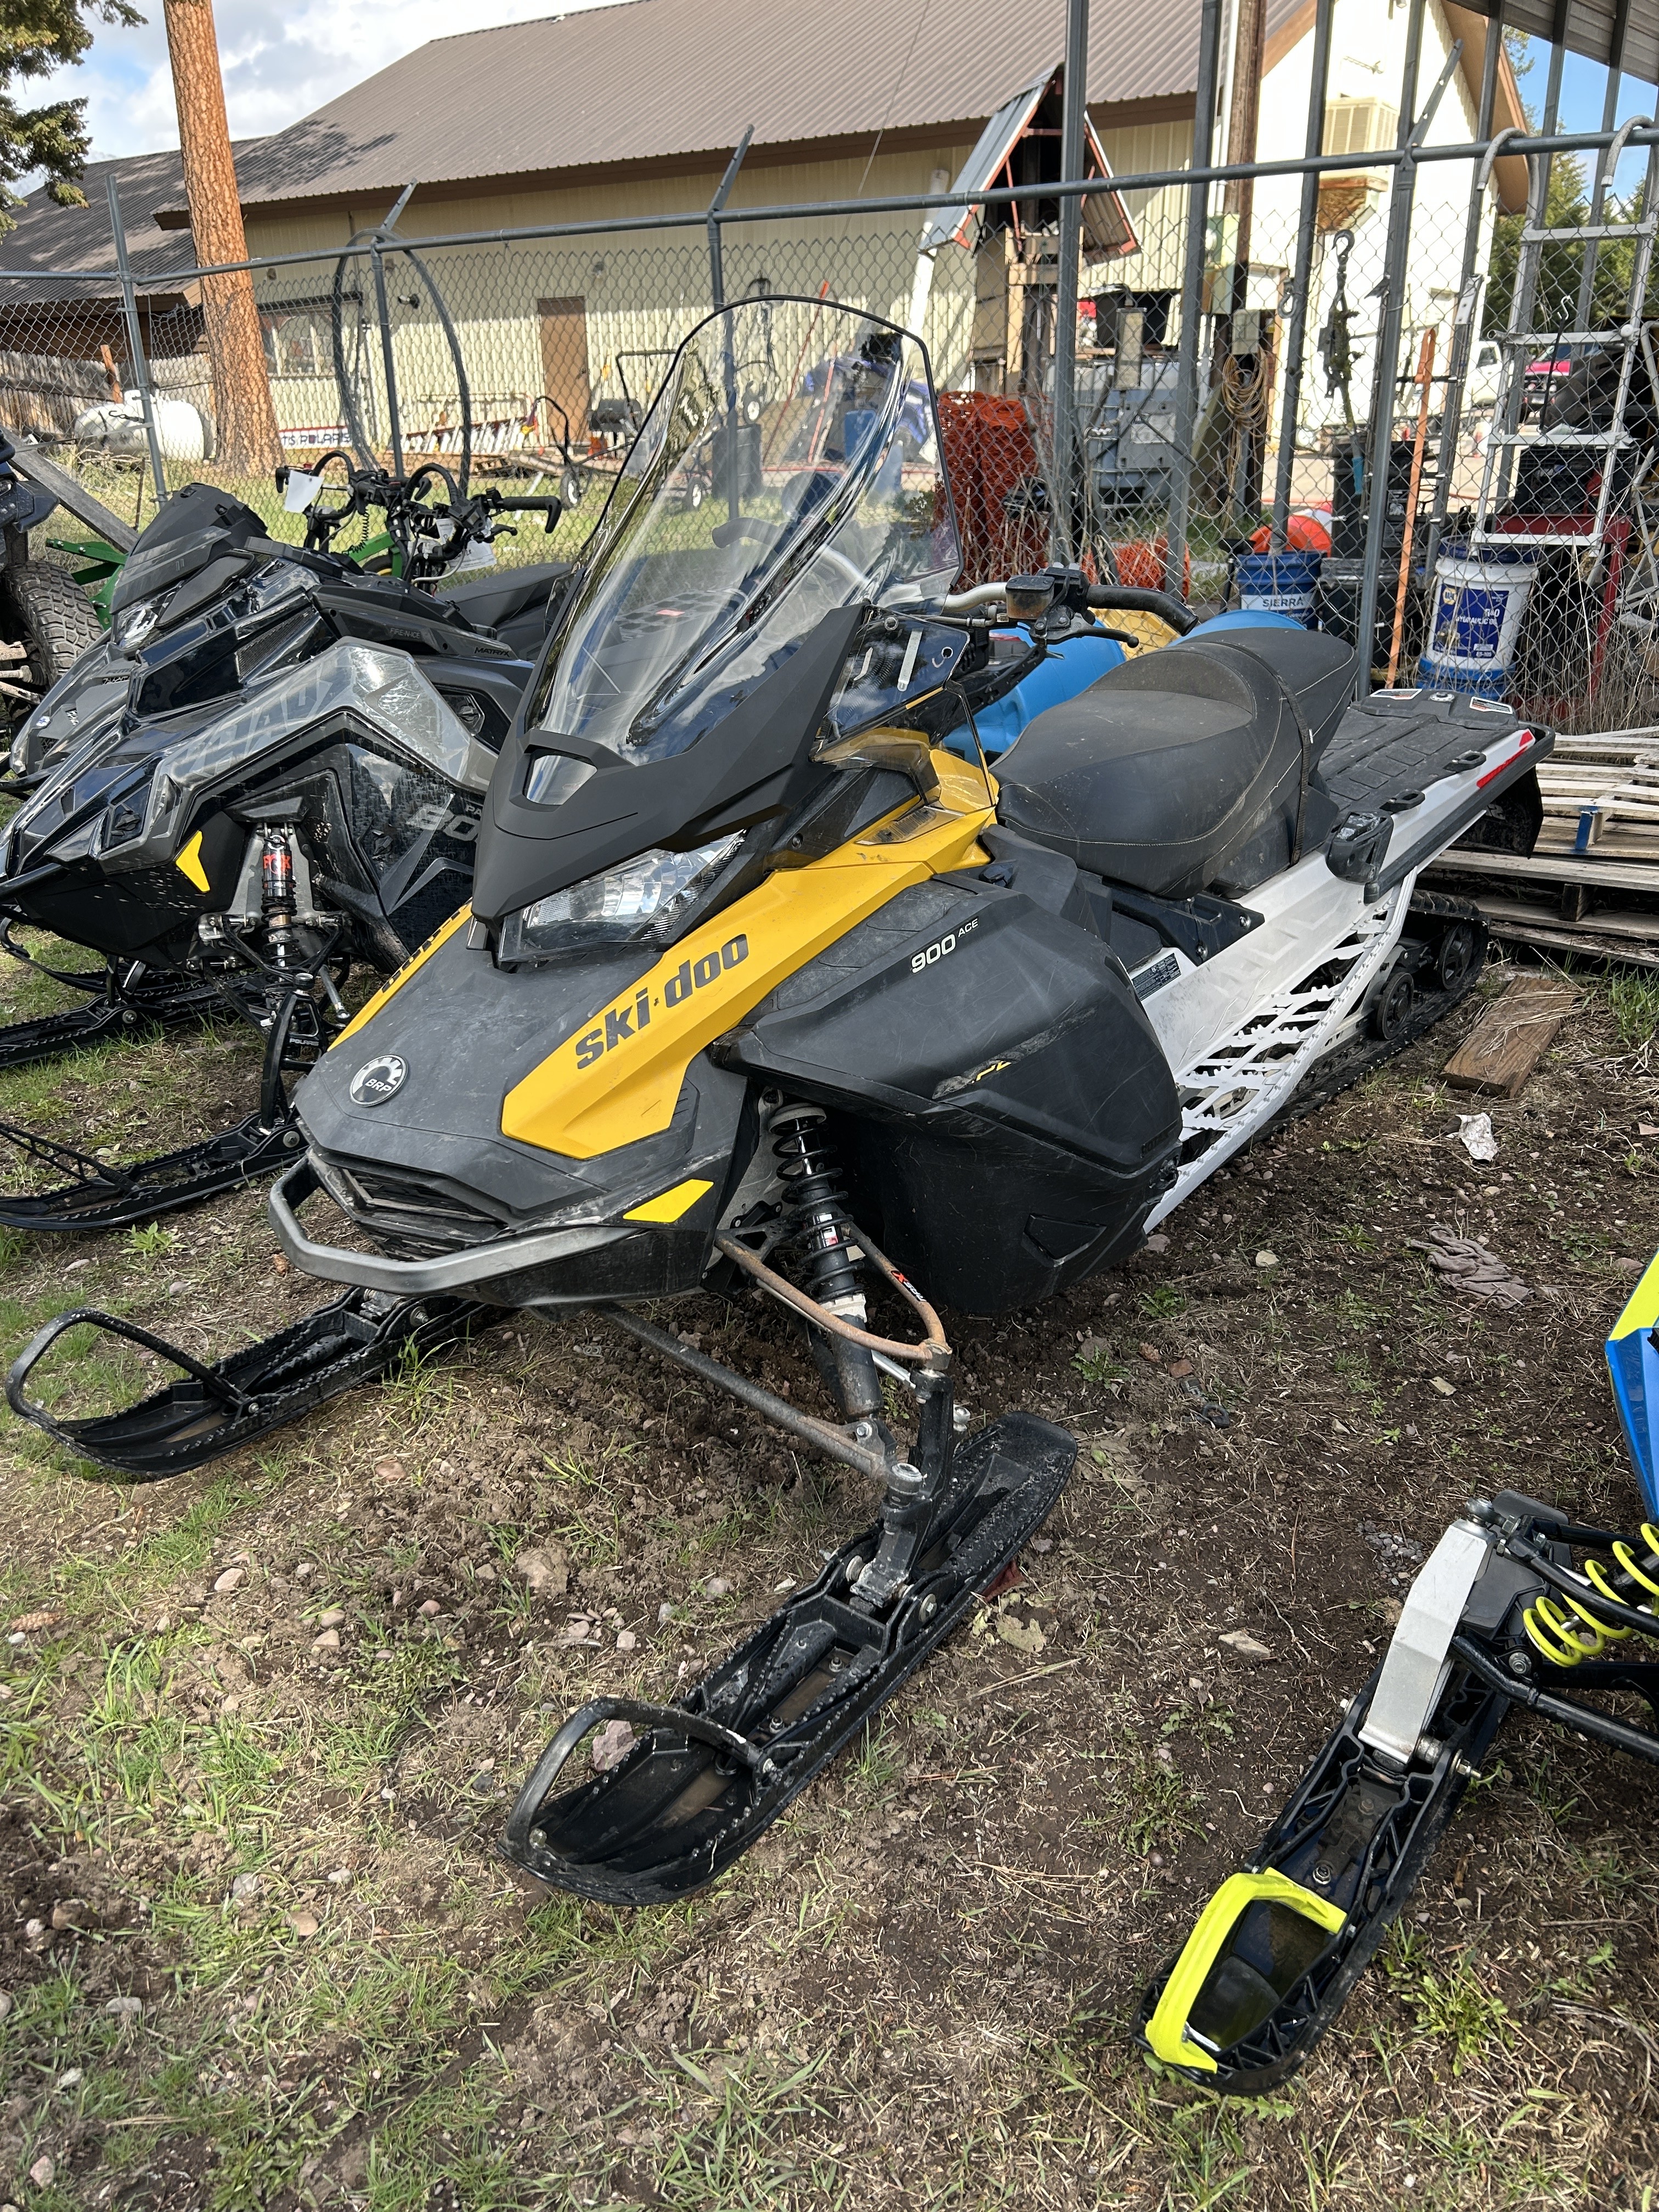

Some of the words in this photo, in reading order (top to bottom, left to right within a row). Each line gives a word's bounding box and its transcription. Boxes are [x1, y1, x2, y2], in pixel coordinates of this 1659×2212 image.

[474, 647, 510, 658] MATRYX
[263, 853, 291, 875] FOX
[911, 934, 956, 973] 900
[957, 918, 979, 938] ACE
[365, 1078, 392, 1092] BRP
